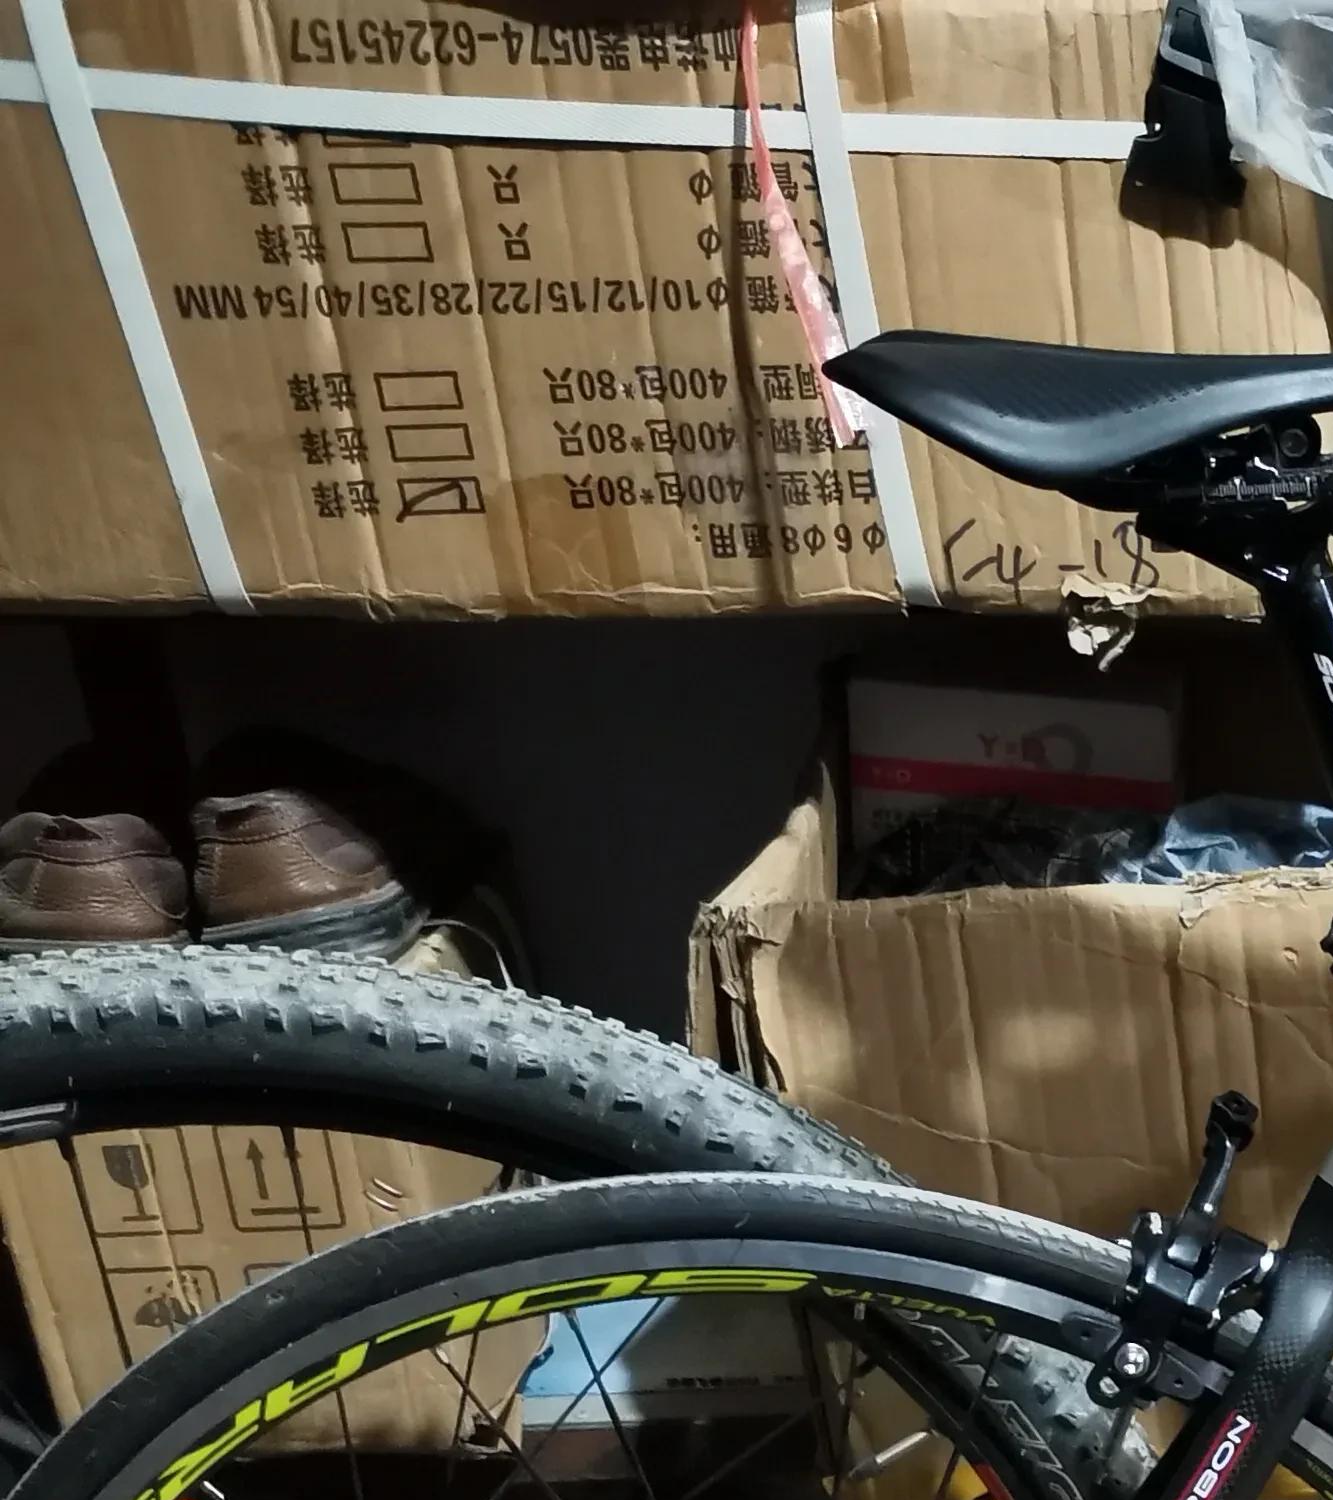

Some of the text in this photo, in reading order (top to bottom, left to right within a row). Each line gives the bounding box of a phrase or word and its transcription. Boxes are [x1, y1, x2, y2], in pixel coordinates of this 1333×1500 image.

[241, 163, 311, 207] 选择
[487, 164, 521, 206] 只
[255, 222, 328, 265] 选择
[496, 221, 531, 261] 只
[287, 373, 357, 414] 选择
[299, 427, 369, 466] 选择
[311, 478, 381, 519] 选择
